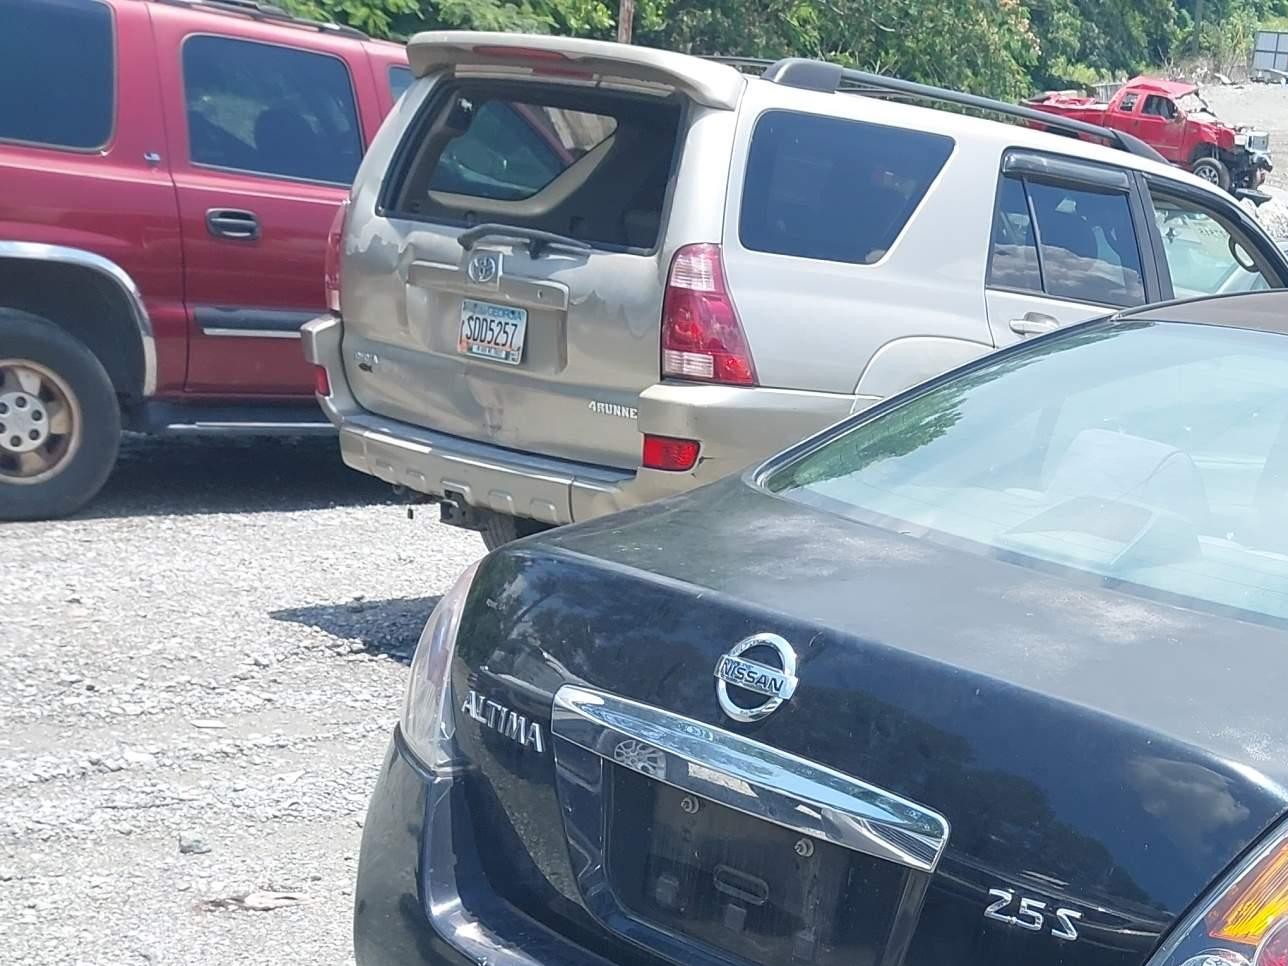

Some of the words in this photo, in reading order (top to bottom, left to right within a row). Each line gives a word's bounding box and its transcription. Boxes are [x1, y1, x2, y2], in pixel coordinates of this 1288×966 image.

[465, 315, 519, 350] SDD5257
[720, 658, 784, 692] NISSAN
[461, 690, 545, 752] ALTIMA
[1051, 908, 1082, 940] S
